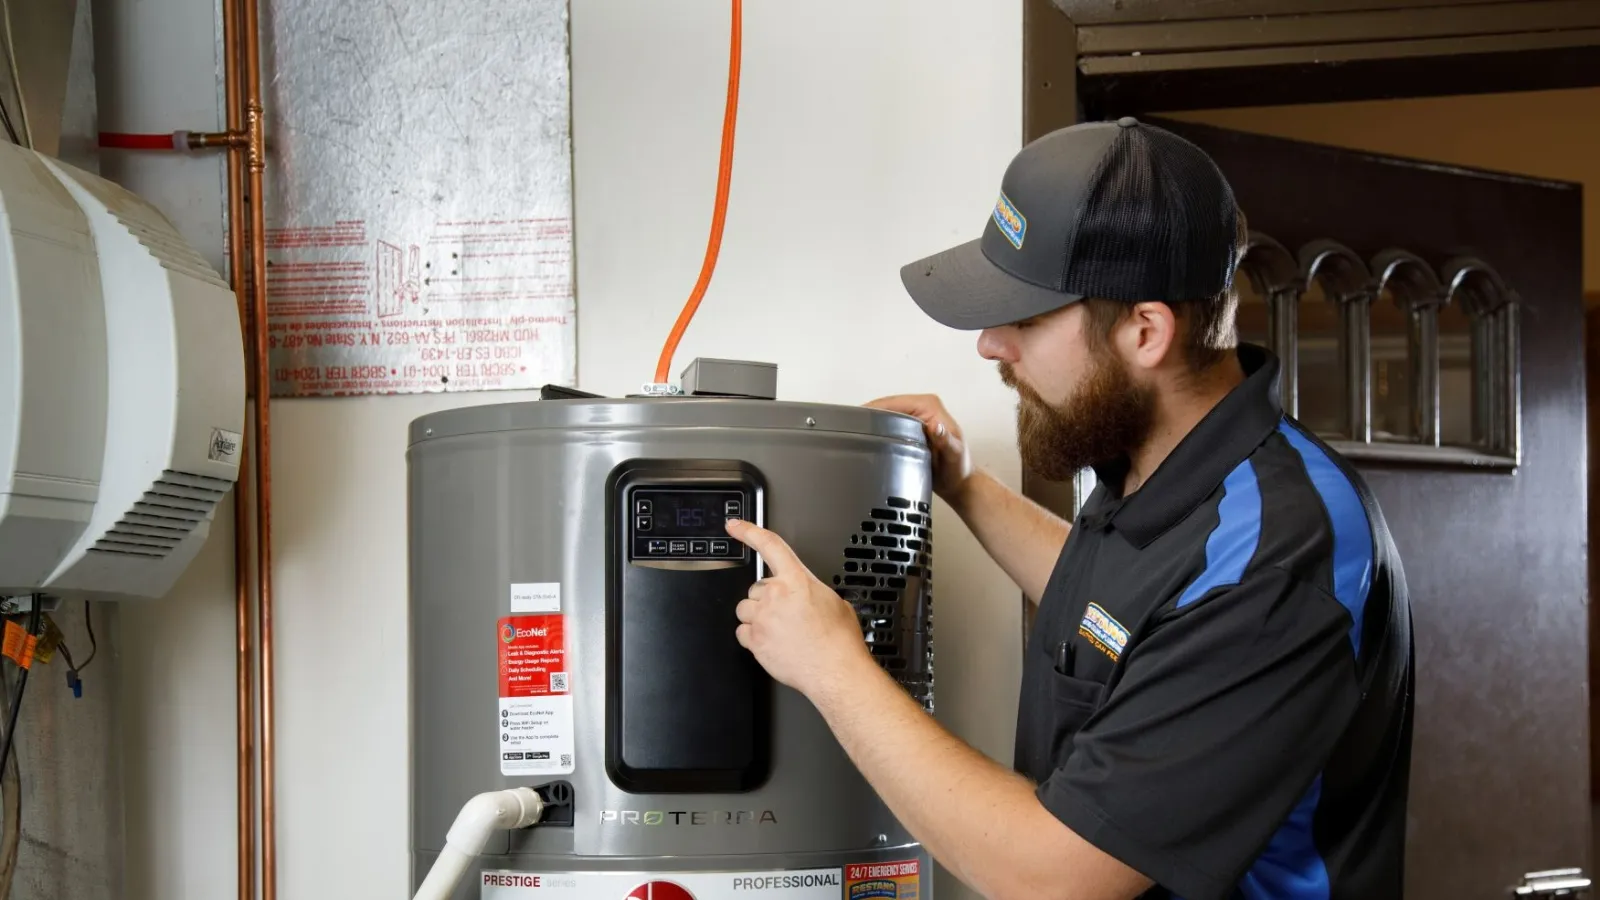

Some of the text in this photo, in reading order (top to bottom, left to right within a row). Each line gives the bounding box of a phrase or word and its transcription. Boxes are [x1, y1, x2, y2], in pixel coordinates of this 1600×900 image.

[305, 320, 372, 331] Instrucciones
[382, 319, 442, 328] Instructions
[446, 318, 502, 328] Installation
[326, 333, 355, 347] State
[433, 330, 455, 344] PFS
[514, 328, 539, 342] HUD
[476, 347, 490, 359] ES
[326, 367, 348, 380] TER
[456, 364, 477, 378] TER
[516, 628, 547, 637] EcoNet
[600, 810, 778, 825] PROTERRA
[850, 866, 867, 878] 24/7
[868, 864, 899, 877] EMERGENCY
[484, 874, 541, 888] PRESTIGE
[734, 873, 840, 890] PROFESSIONAL
